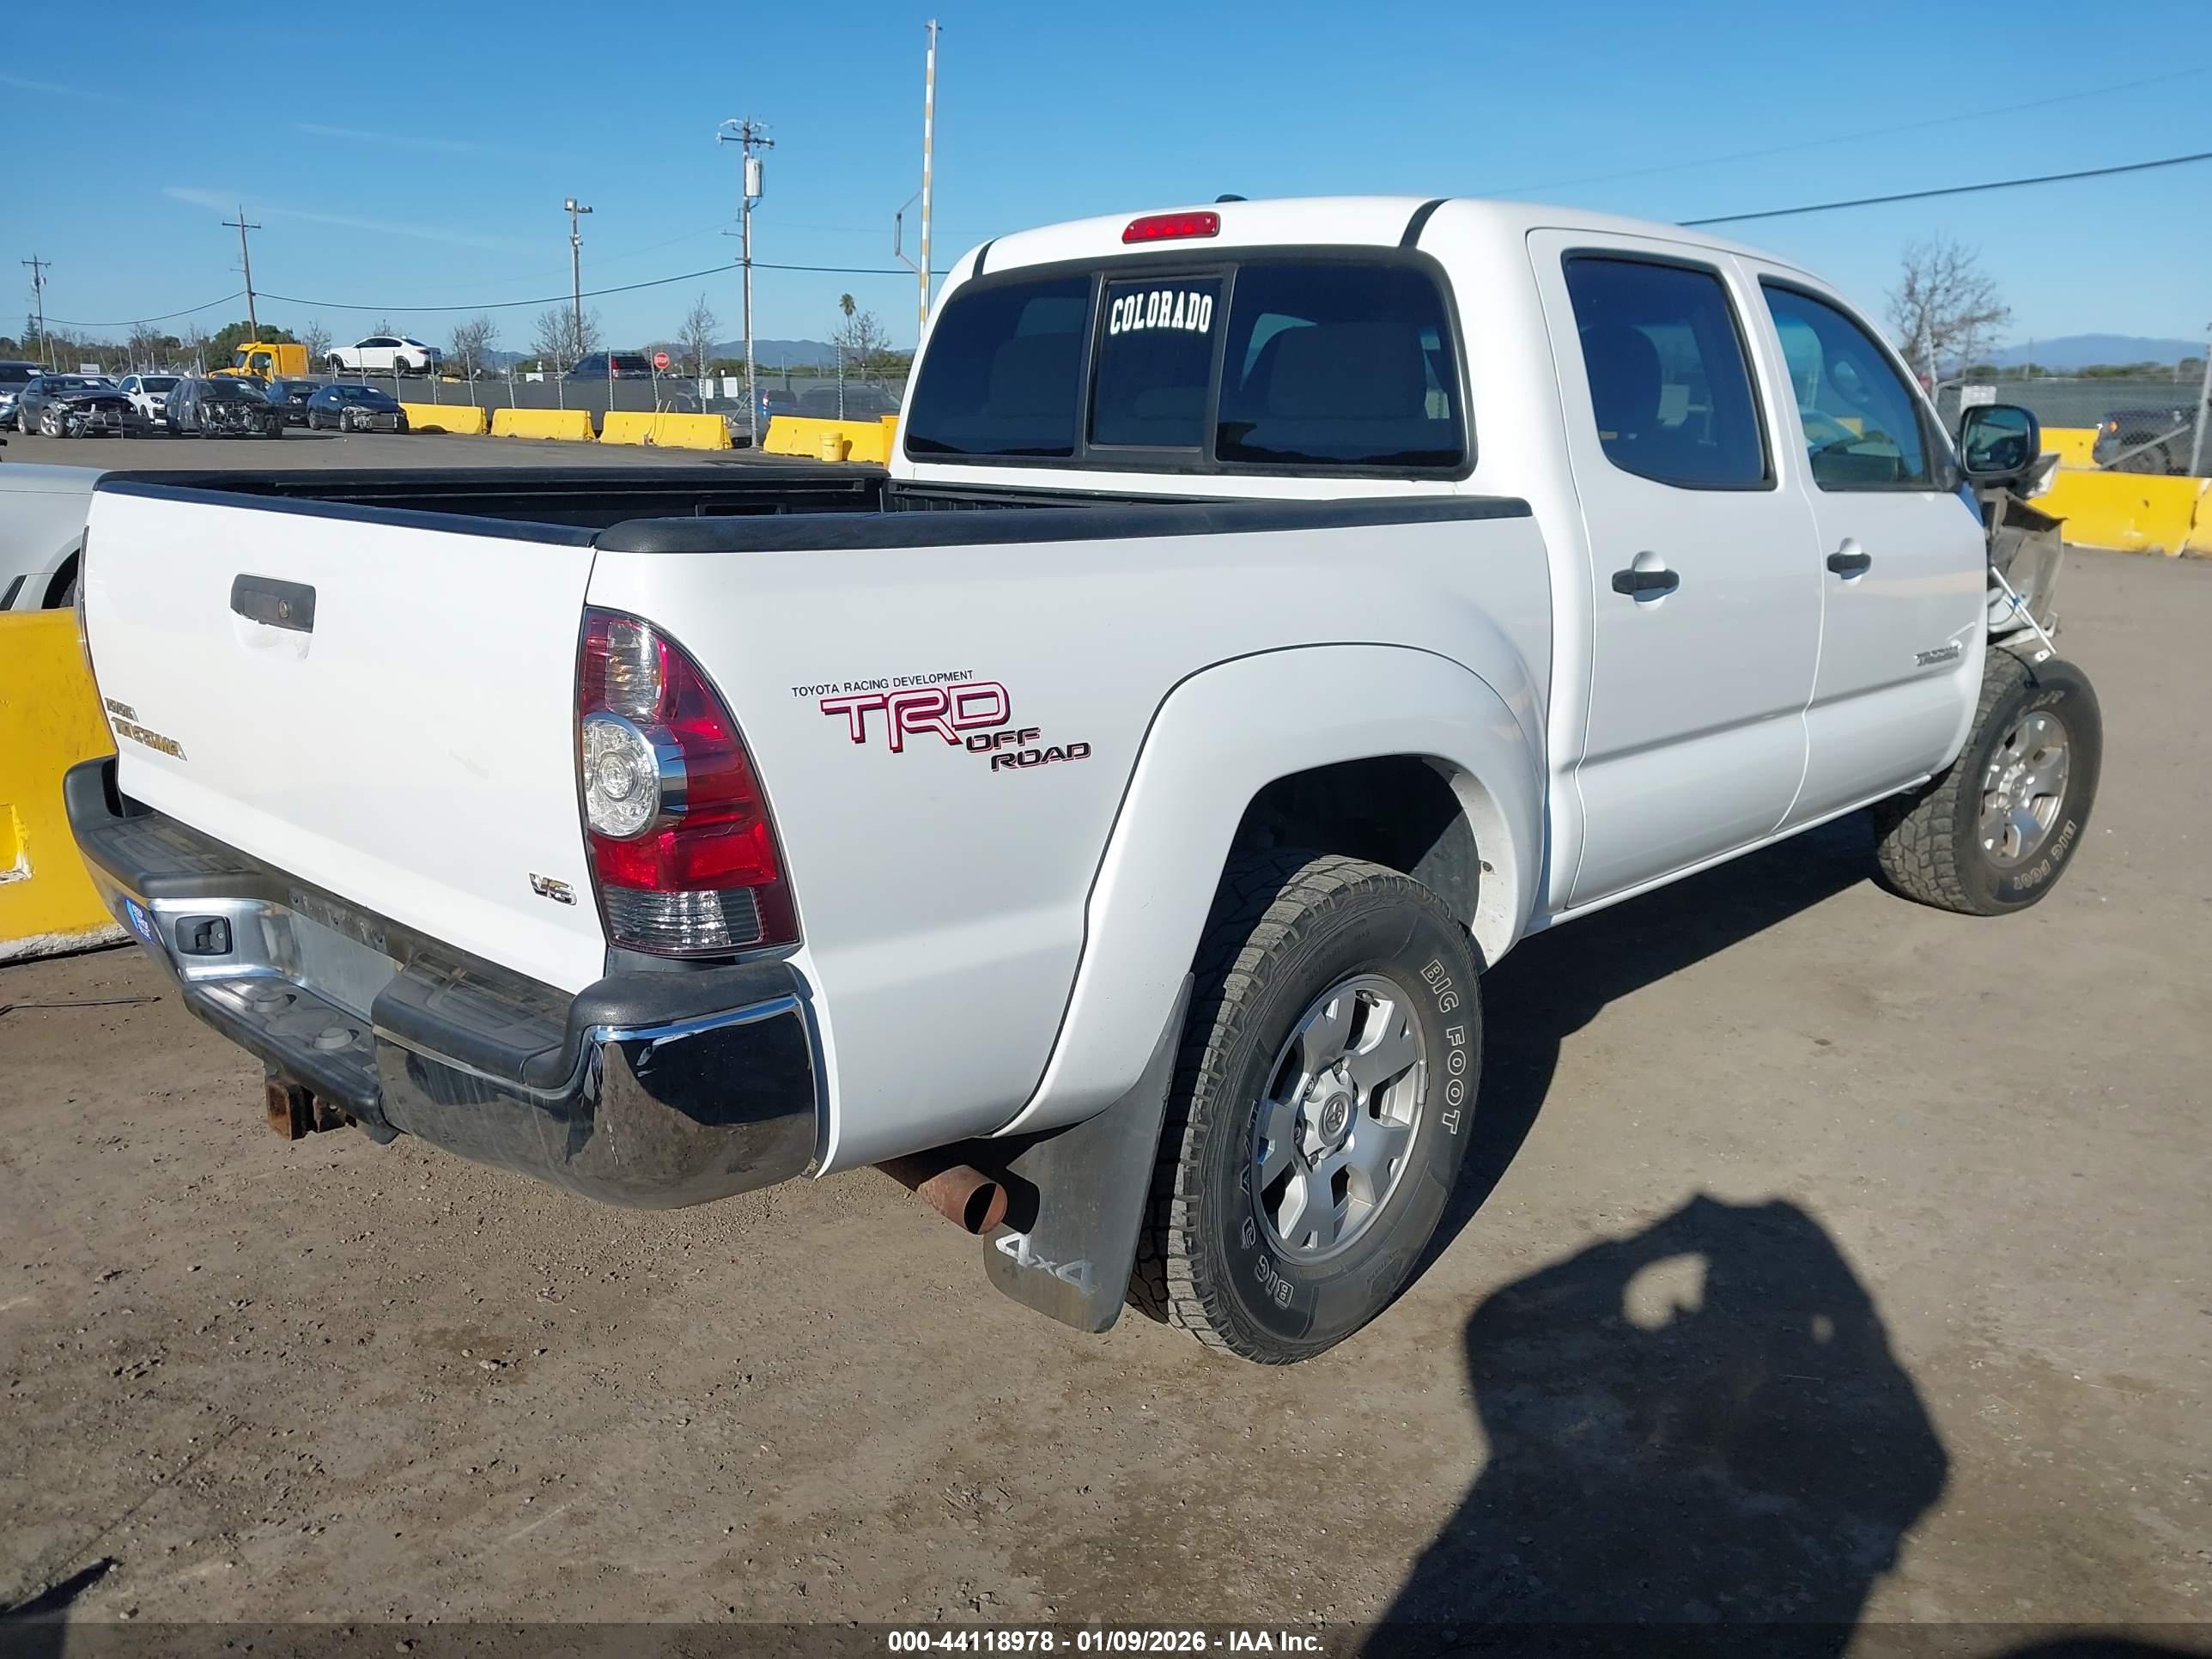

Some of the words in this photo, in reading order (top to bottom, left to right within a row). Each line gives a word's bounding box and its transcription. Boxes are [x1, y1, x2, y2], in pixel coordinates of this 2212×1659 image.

[1109, 290, 1213, 336] COLORADO
[792, 683, 840, 698] TOYOTA
[843, 678, 890, 695] RACING
[892, 670, 975, 689] DEVELOPMENT
[820, 681, 1012, 753] TRD
[965, 726, 1042, 754] OFF
[990, 742, 1092, 773] ROAD
[529, 872, 578, 906] V6
[2013, 858, 2051, 890] FOOT
[1419, 957, 1460, 1014] BIG
[1441, 1024, 1467, 1135] FOOT
[1255, 1253, 1295, 1310] BIG
